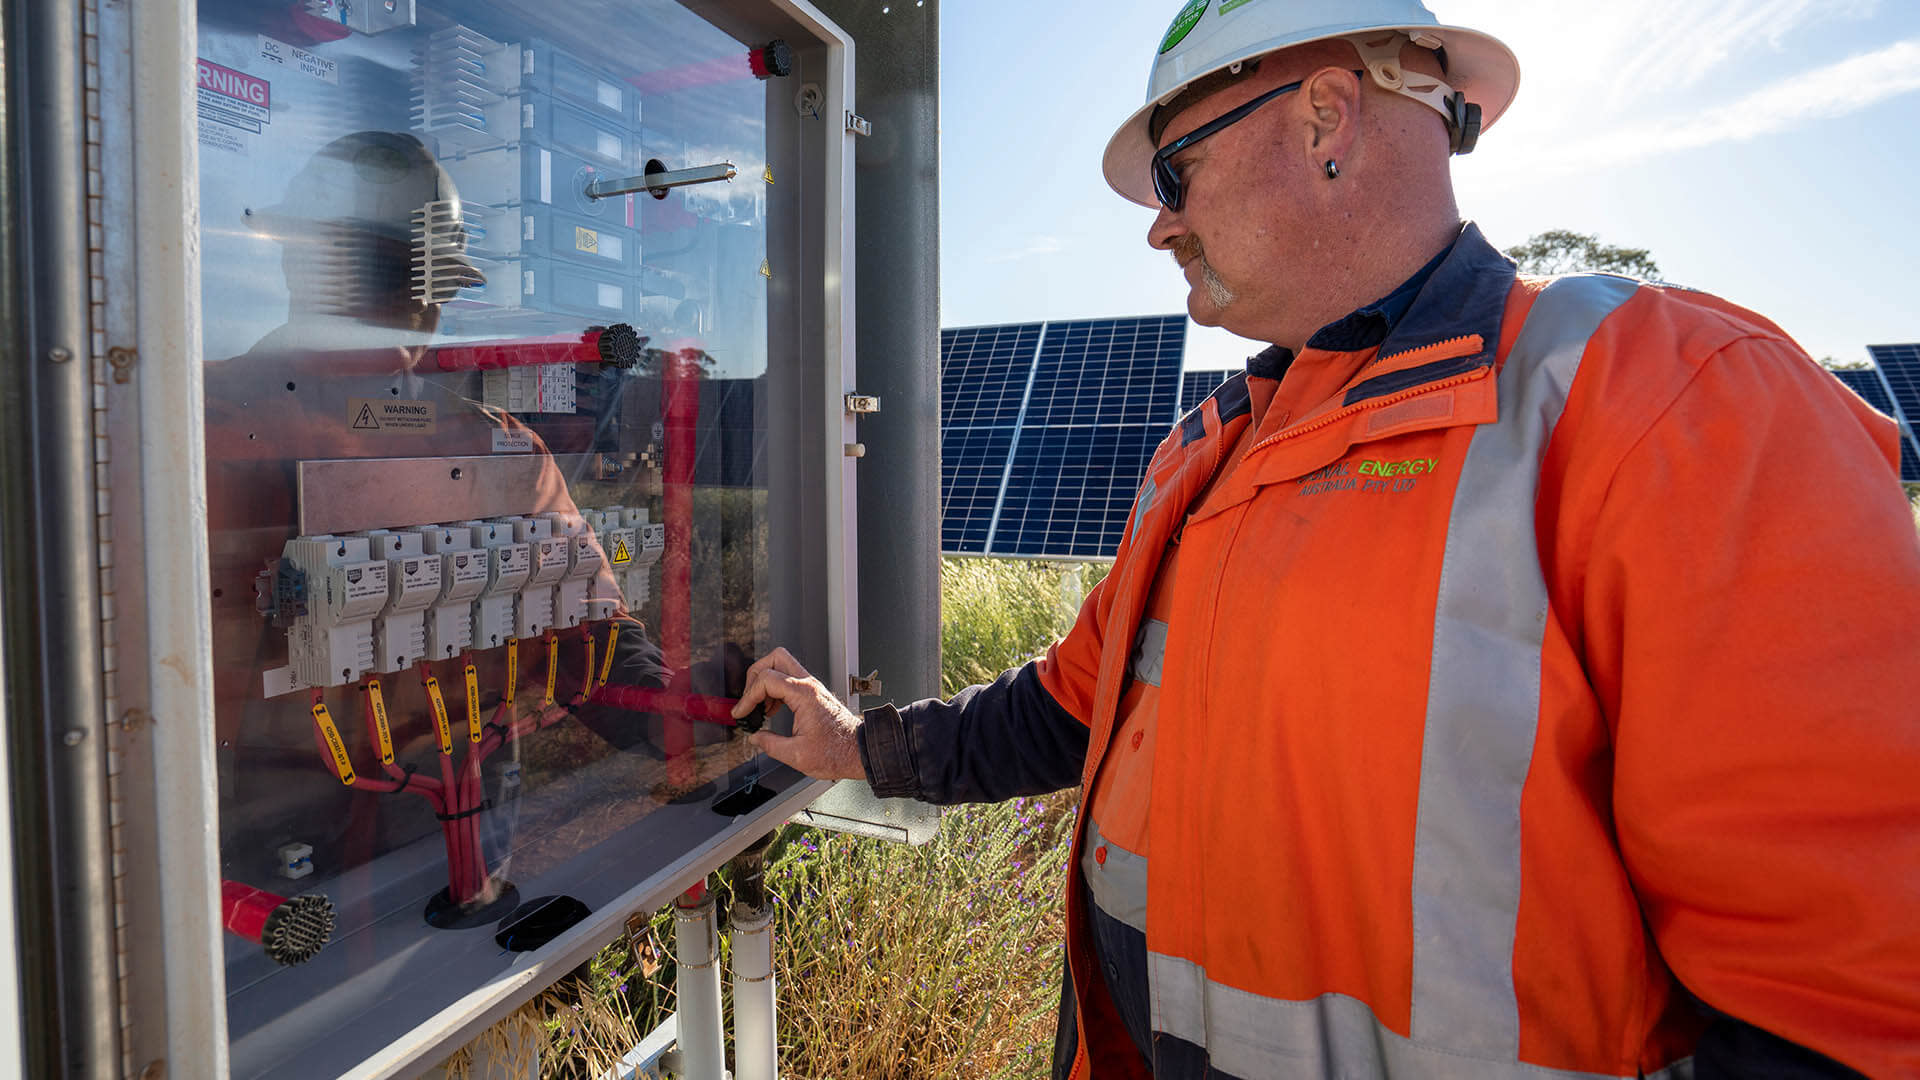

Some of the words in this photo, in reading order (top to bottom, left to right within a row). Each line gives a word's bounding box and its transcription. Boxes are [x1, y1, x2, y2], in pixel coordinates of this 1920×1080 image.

[264, 41, 280, 54] DC
[291, 49, 334, 71] NEGATIVE
[300, 62, 327, 78] INPUT
[197, 62, 265, 104] RNING
[383, 405, 428, 416] WARNING
[1358, 457, 1440, 478] ENERGY
[1299, 477, 1358, 497] AUSTRALIA
[1361, 479, 1389, 494] PTY
[1393, 478, 1417, 493] LTD
